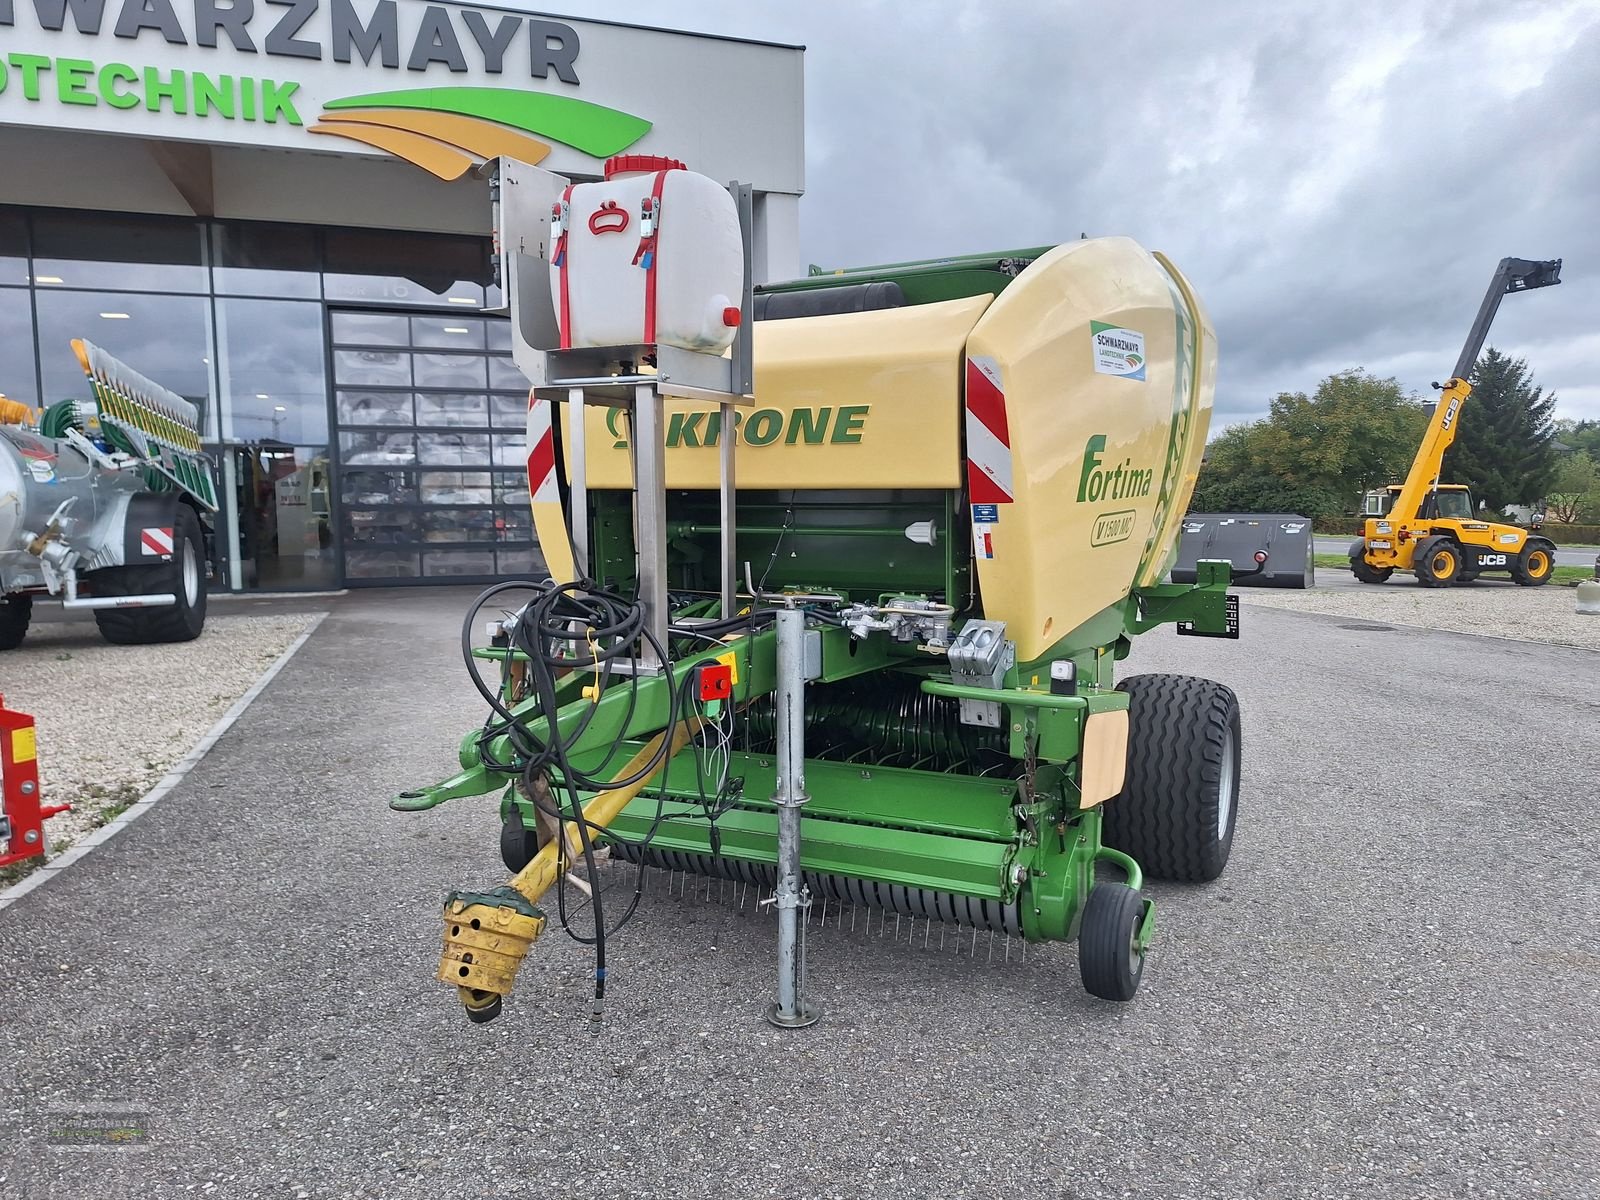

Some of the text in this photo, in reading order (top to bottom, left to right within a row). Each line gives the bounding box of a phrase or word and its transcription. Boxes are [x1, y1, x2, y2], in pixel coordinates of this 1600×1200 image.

[0, 52, 303, 126] TECHNIK
[1097, 334, 1139, 353] SCHWARZMAYR
[666, 404, 872, 448] KRONE
[1441, 397, 1459, 430] JCB
[1076, 434, 1153, 503] Fortima
[1096, 521, 1106, 540] V
[1103, 519, 1121, 538] 1500
[1478, 554, 1507, 566] JCB
